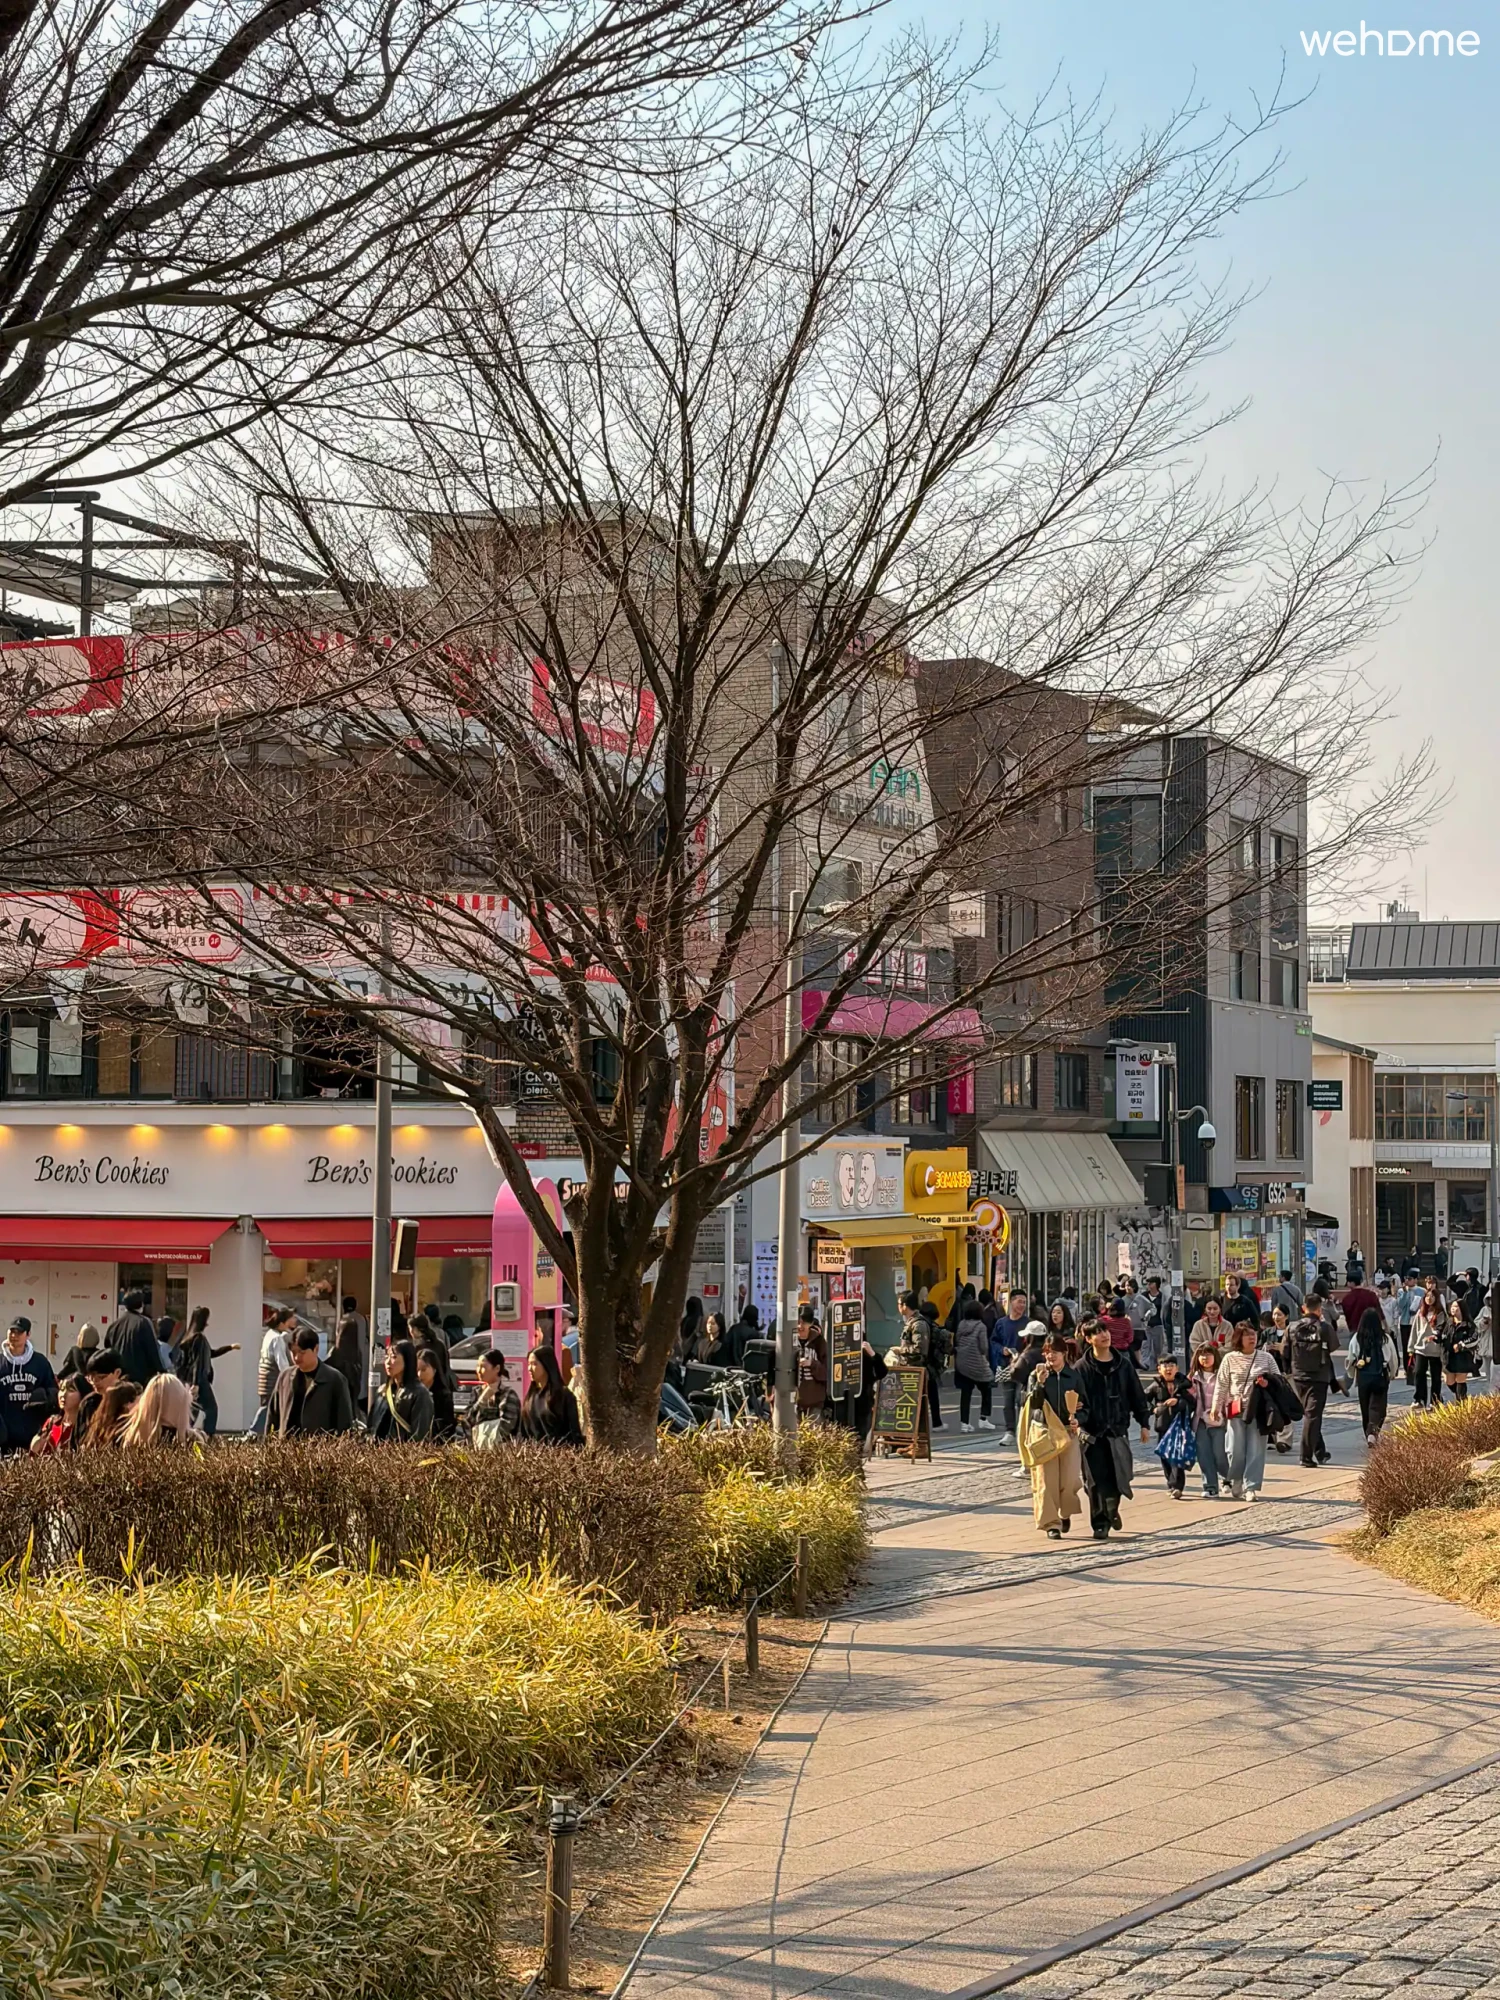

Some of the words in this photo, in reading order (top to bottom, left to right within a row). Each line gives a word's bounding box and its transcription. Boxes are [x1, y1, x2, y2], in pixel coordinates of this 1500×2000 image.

[950, 909, 978, 920] 부동산
[1119, 1053, 1137, 1062] The
[1139, 1053, 1152, 1062] KU
[34, 1155, 91, 1184] Ben's
[95, 1156, 170, 1185] Cookies
[306, 1156, 372, 1185] Ben's
[391, 1157, 459, 1185] ookies
[810, 1178, 830, 1192] Coffee
[1241, 1186, 1259, 1198] GS
[1268, 1182, 1287, 1204] GS25
[818, 1246, 846, 1256] 아메리카노
[819, 1256, 845, 1264] 1,500원
[895, 1372, 920, 1431] 플스방
